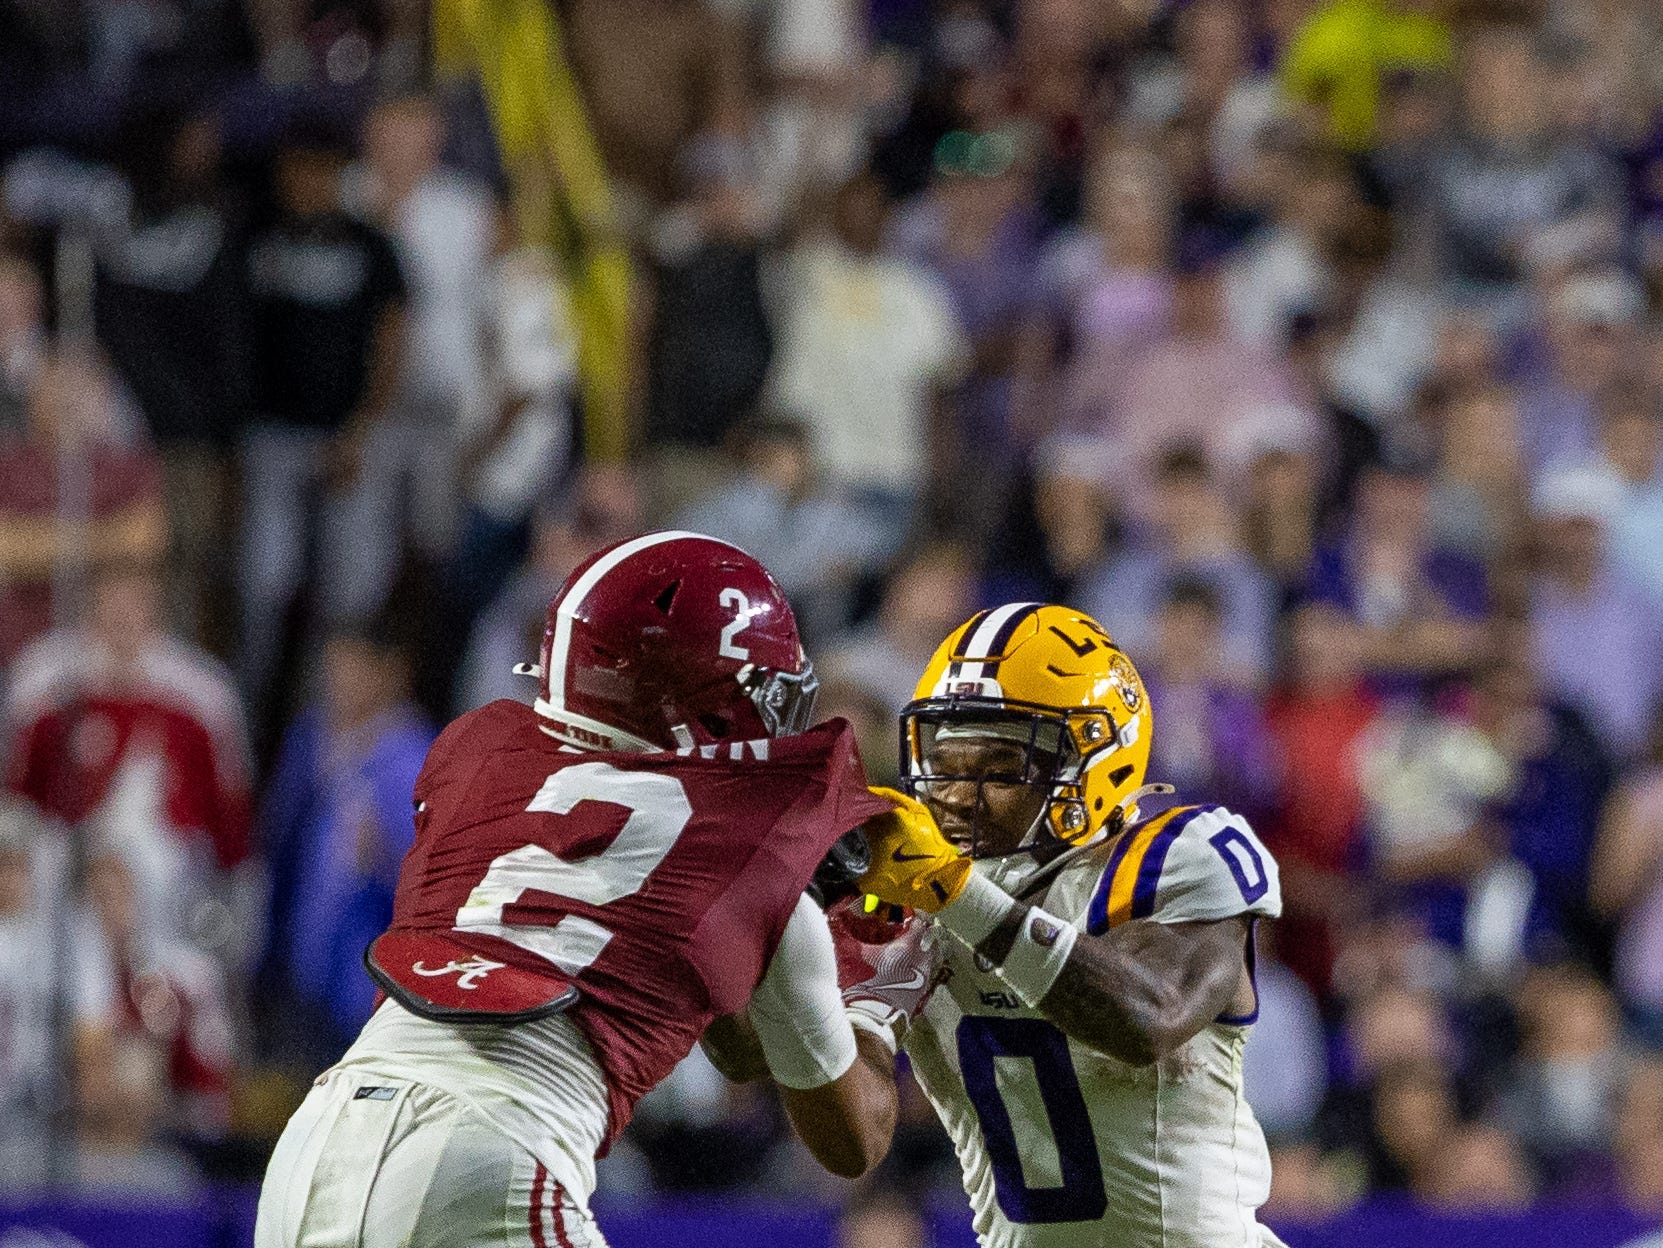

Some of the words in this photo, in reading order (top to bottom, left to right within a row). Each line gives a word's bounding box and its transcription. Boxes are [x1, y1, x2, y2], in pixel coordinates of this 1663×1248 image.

[718, 587, 766, 662] 2
[453, 762, 693, 976] 2
[956, 1014, 1109, 1224] 0
